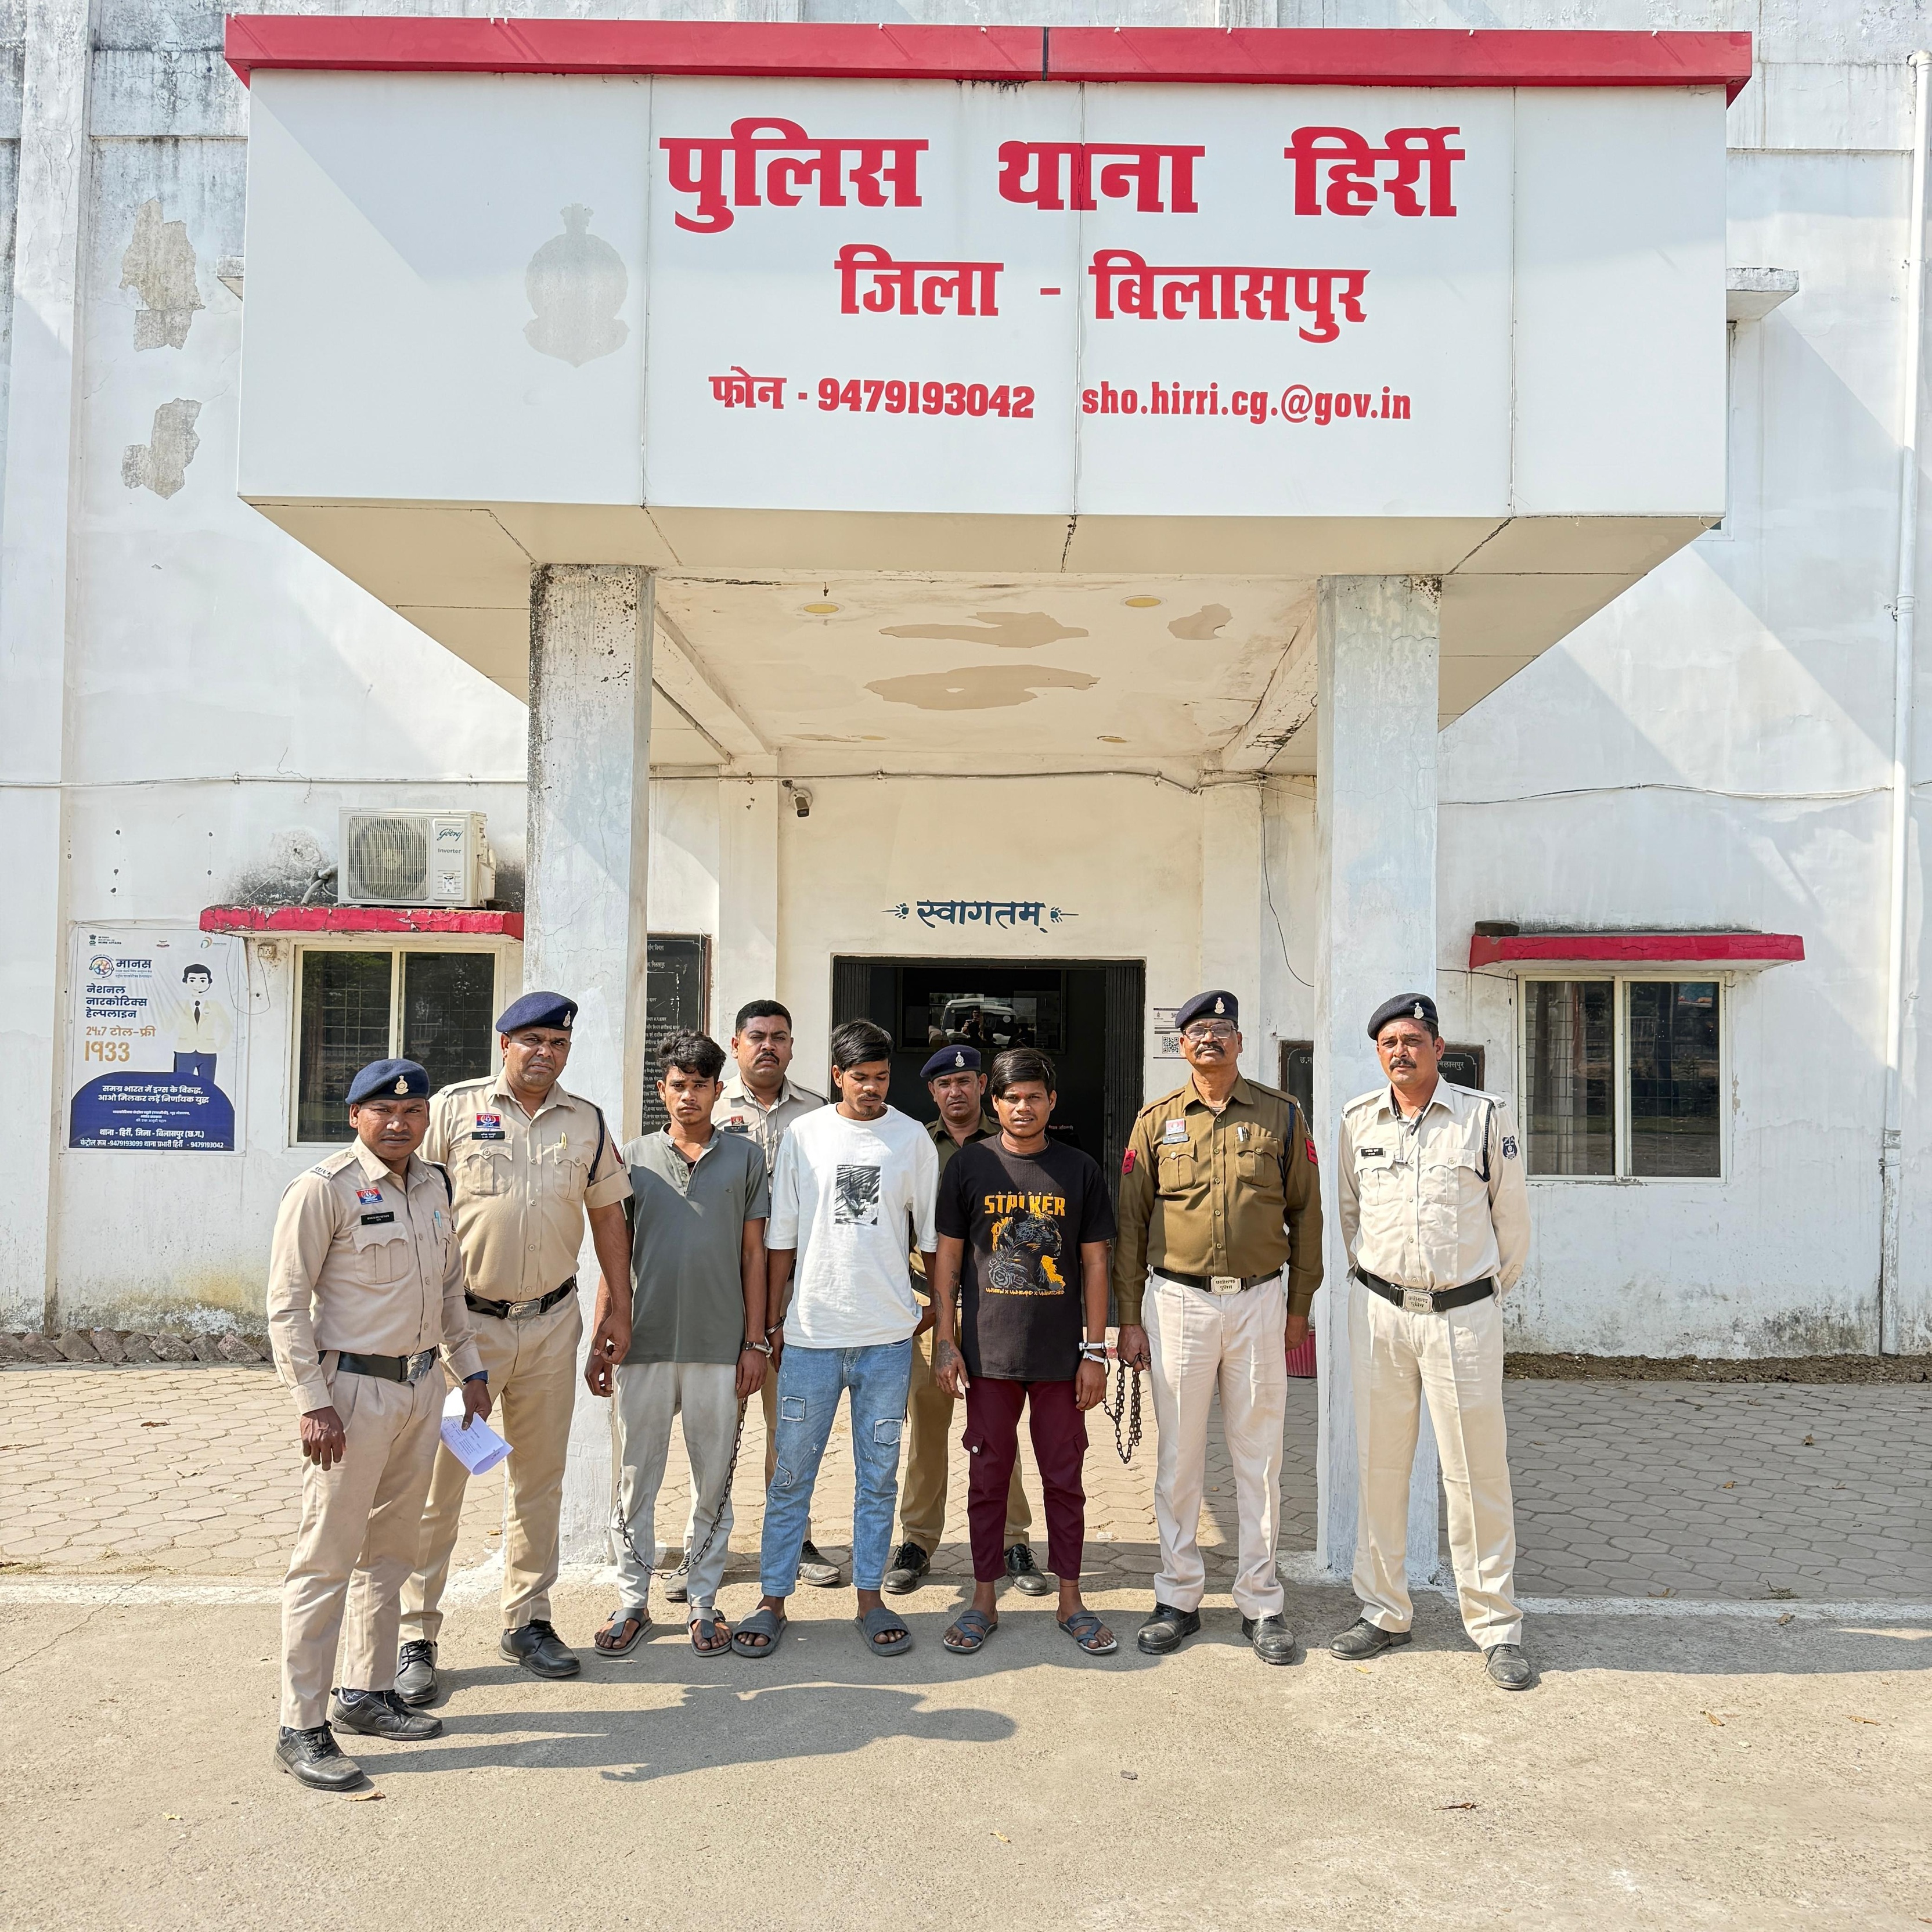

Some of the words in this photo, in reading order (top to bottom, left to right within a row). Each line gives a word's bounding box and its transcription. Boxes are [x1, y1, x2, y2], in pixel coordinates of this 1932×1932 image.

[659, 118, 929, 233] पुलिस
[999, 141, 1205, 213] थाना
[1284, 127, 1465, 217] हिर्री
[834, 244, 1004, 316] जिला
[1088, 250, 1369, 343] बिलासपुर
[709, 366, 787, 409] फोन
[819, 378, 1035, 419] 9479193042
[1082, 381, 1410, 426] sho.hirri.cg.@gov.in
[437, 828, 464, 842] Godrej
[916, 899, 1048, 933] स्वागतम्
[116, 959, 152, 968] मानस
[86, 983, 126, 994] नेशनल
[86, 995, 147, 1006] नारकोटिक्स
[85, 1007, 137, 1018] हेल्पलाइन
[86, 1026, 107, 1036] 24x7
[109, 1025, 156, 1037] टोल-फ्री
[85, 1040, 130, 1062] 1933
[145, 1084, 153, 1093] में
[170, 1085, 178, 1093] के
[179, 1085, 203, 1094] विरुद्ध,
[98, 1093, 116, 1101] आओ
[118, 1093, 147, 1102] मिलकर
[161, 1094, 194, 1102] निर्णायक
[195, 1096, 210, 1105] युद्ध
[135, 1129, 151, 1137] जिला
[80, 1138, 96, 1147] कंट्रोल
[984, 1194, 1066, 1217] STALKER
